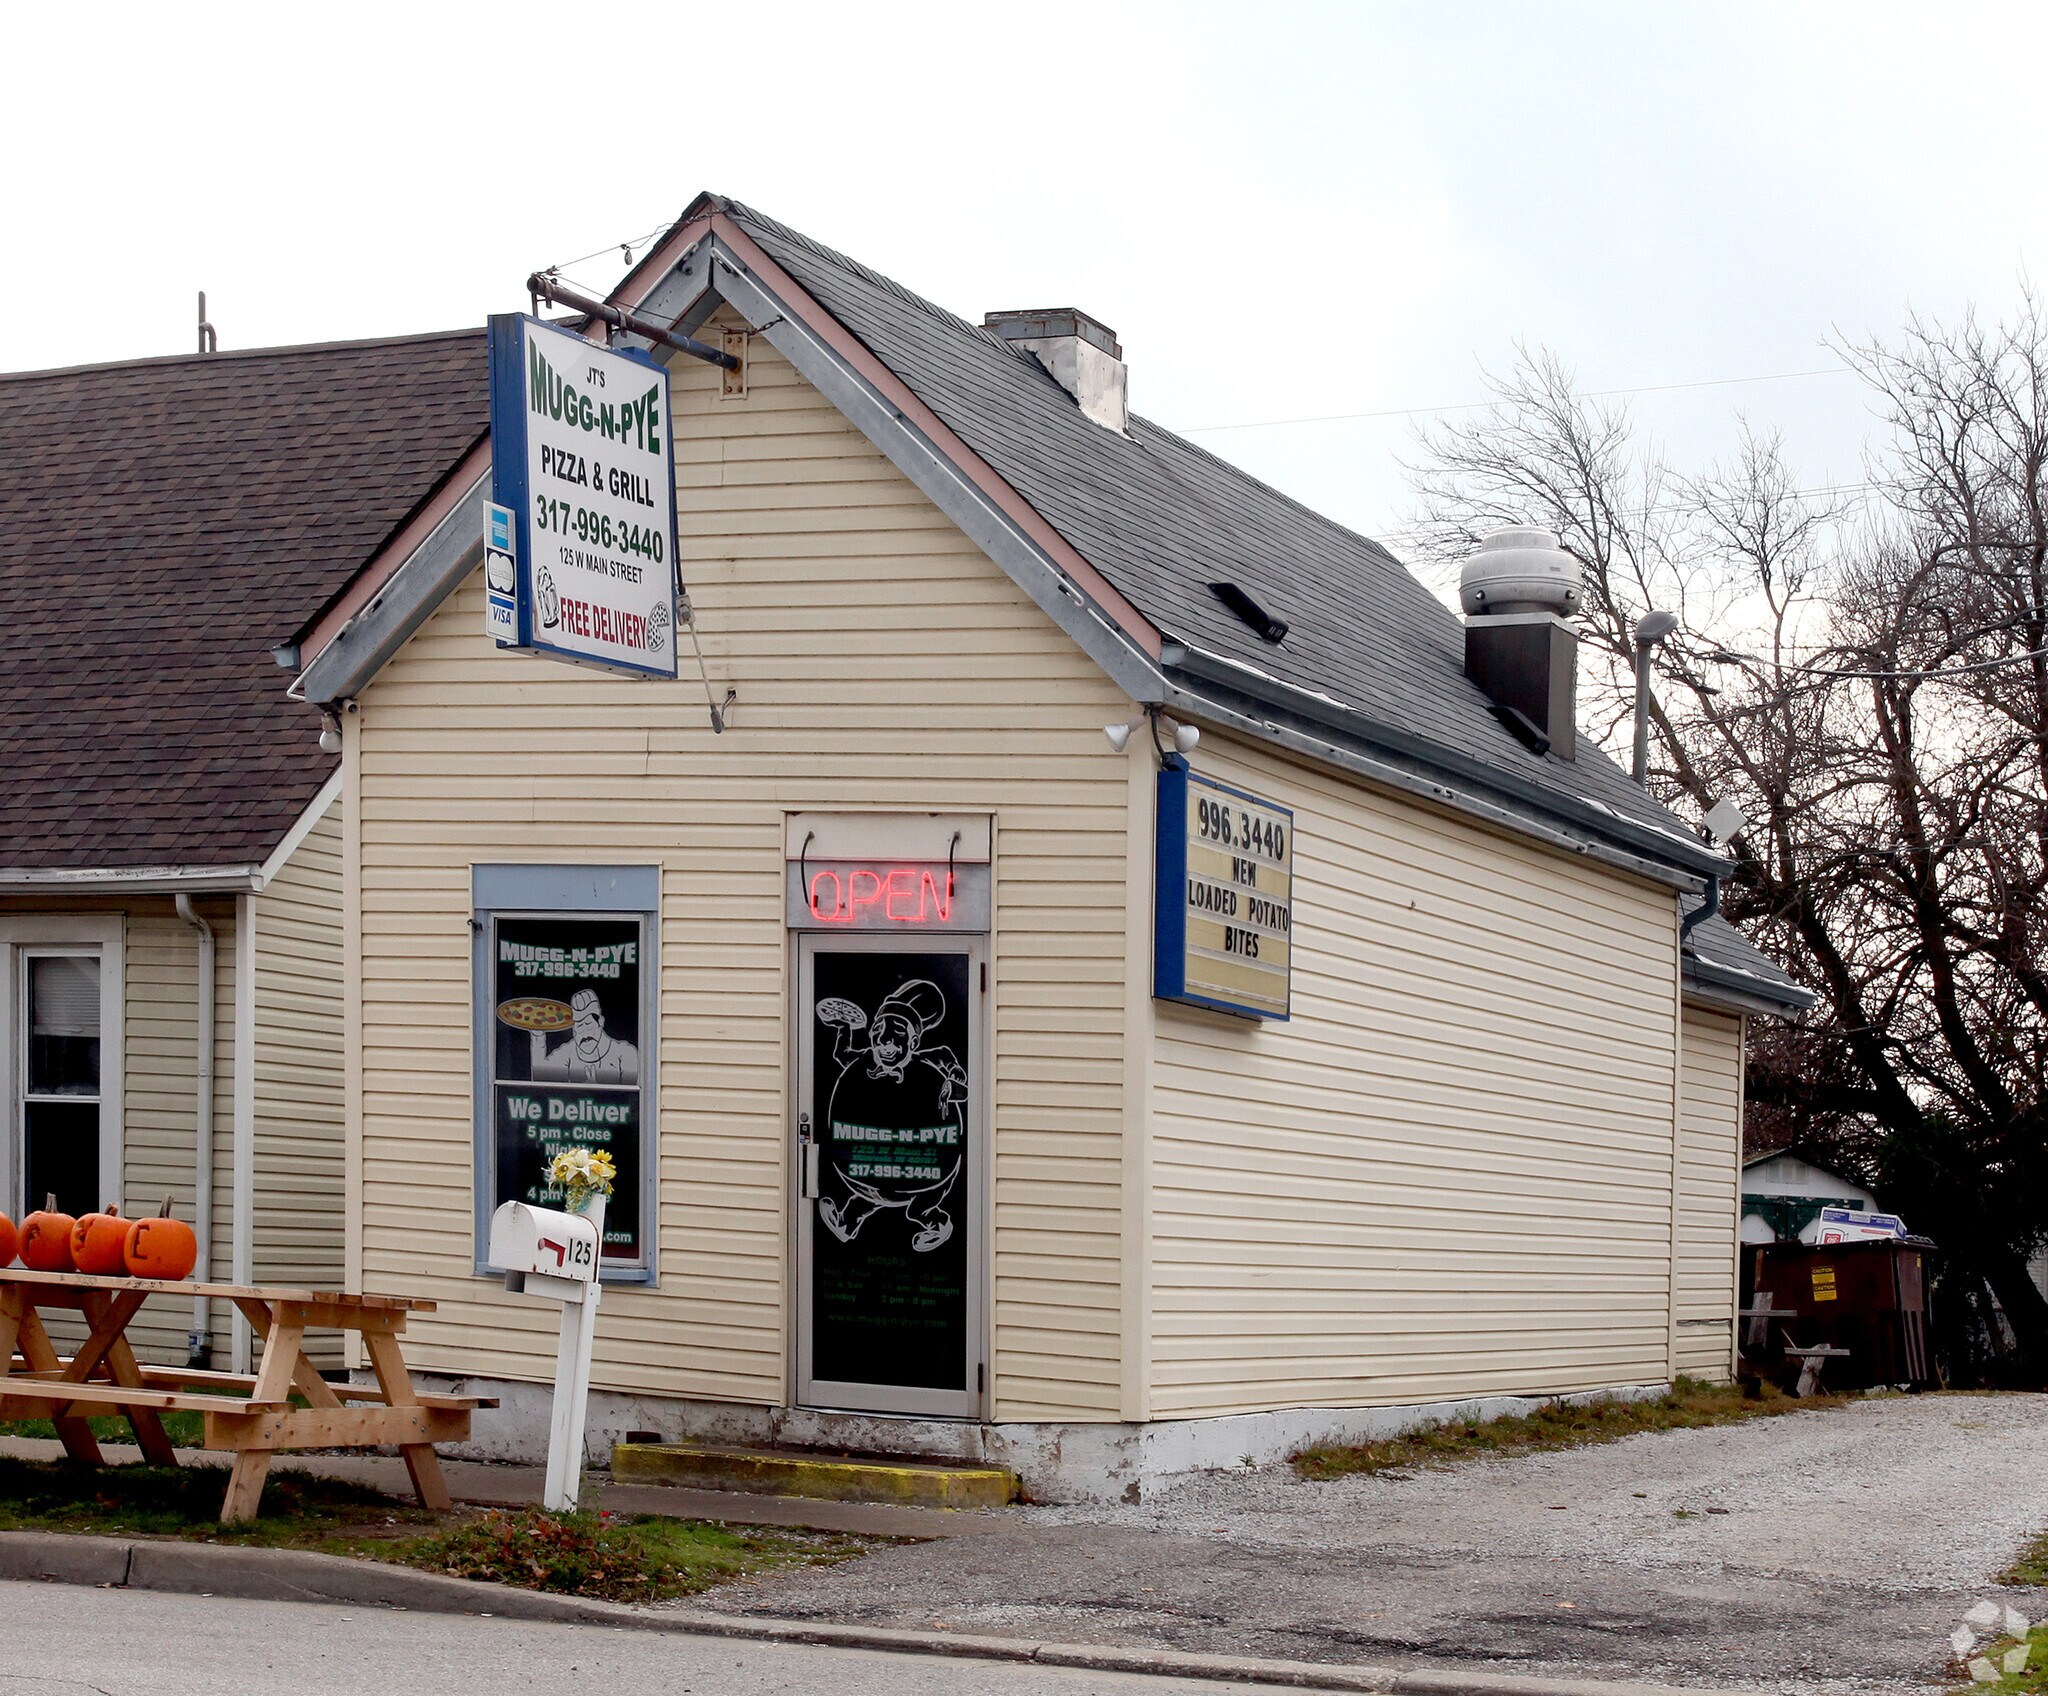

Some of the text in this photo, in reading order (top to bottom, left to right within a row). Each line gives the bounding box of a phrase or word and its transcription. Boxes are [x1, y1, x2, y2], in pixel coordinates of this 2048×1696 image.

[587, 367, 605, 388] JT'S
[529, 335, 660, 455] MUGG-N-PYE
[542, 444, 654, 507] PIZZA & GRILL
[537, 495, 663, 563] 317-996-3440
[560, 547, 643, 585] 125 W MAIN STREET
[493, 606, 511, 626] VISA
[560, 598, 646, 650] FREE DELIVERY
[1199, 798, 1284, 861] 996.3440
[810, 870, 955, 921] OPEN
[1188, 879, 1288, 932] LOADED POTATO
[500, 939, 637, 964] MUGG-N-PYE
[1225, 926, 1259, 958] BITES
[515, 962, 620, 979] 317-996-3440
[508, 1098, 630, 1123] We Deliver
[528, 1126, 536, 1140] 5
[539, 1129, 561, 1143] pm
[572, 1127, 611, 1141] Close
[833, 1122, 958, 1144] MUGG-N-PYE
[849, 1163, 941, 1180] 317-996-3440
[527, 1187, 536, 1201] 4
[568, 1238, 592, 1267] 125
[867, 1256, 907, 1267] HOURS
